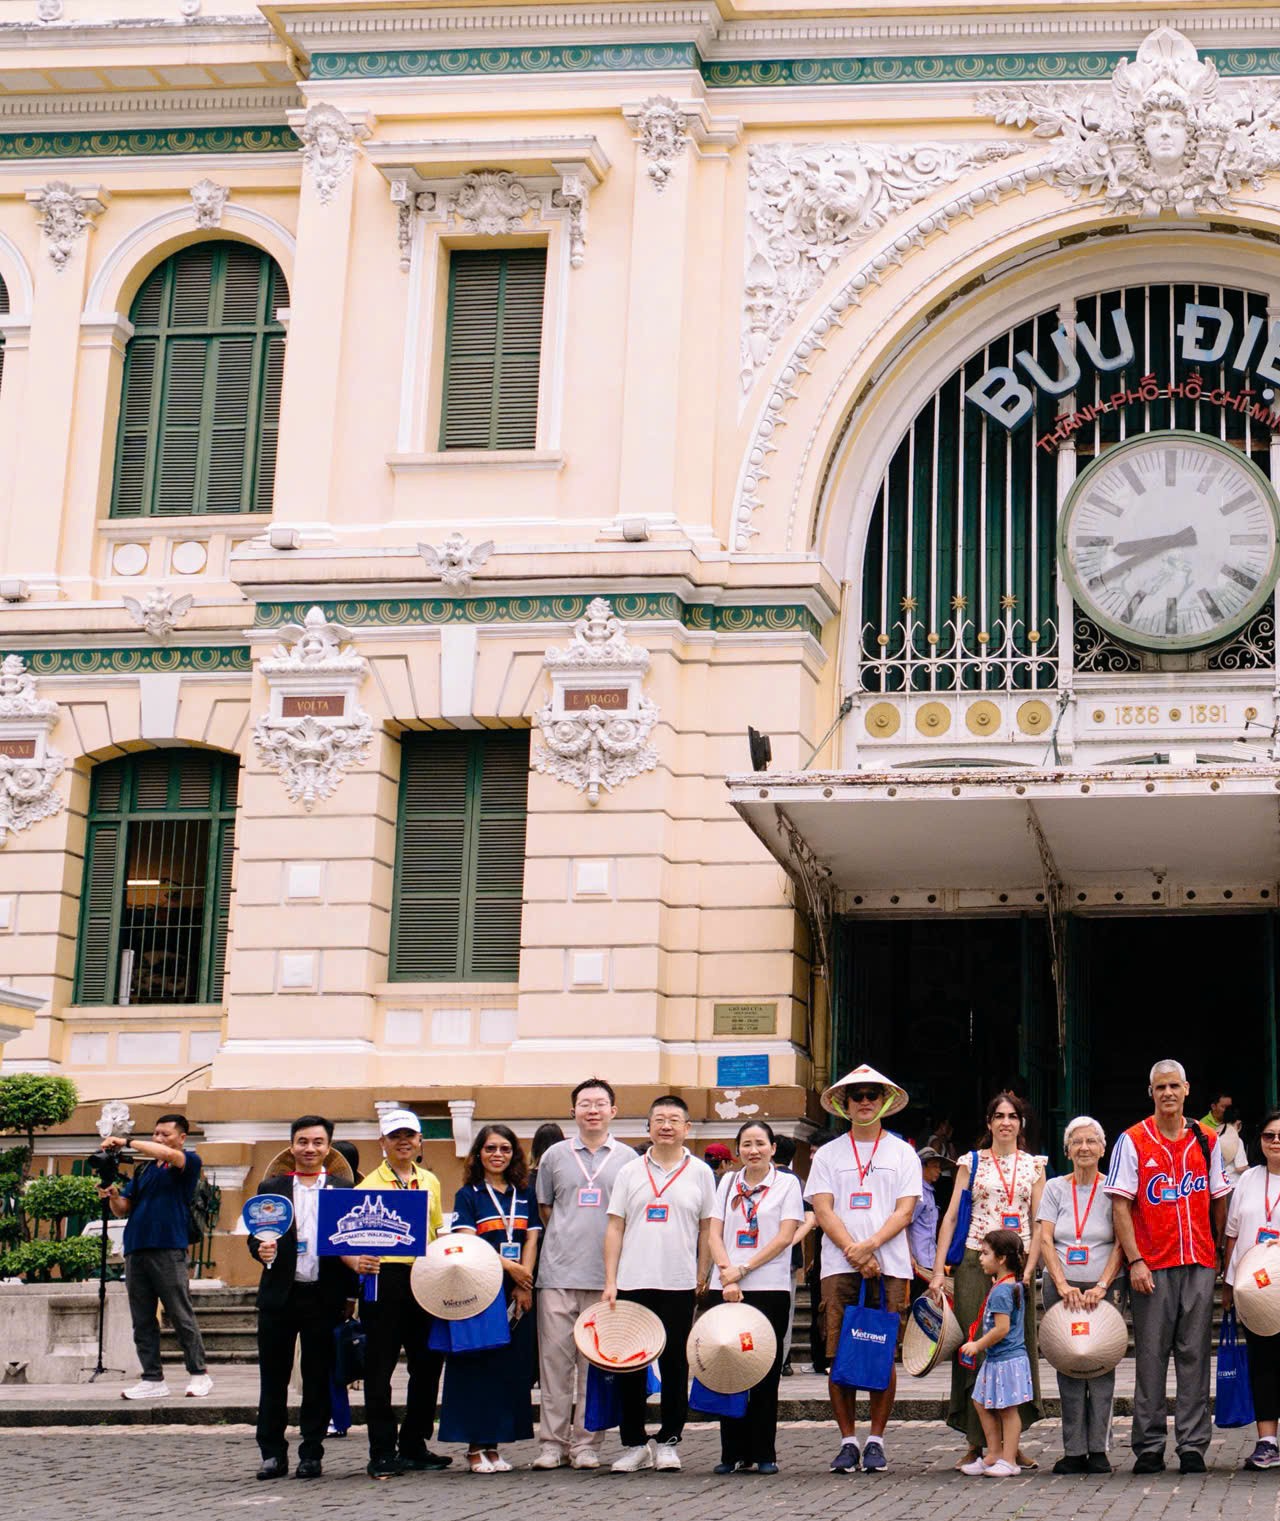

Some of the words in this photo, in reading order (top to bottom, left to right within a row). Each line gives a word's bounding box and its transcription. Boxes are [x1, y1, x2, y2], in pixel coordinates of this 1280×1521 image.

[964, 308, 1136, 431] BƯU
[1035, 403, 1106, 456] THÀNH
[1110, 372, 1159, 411] PHỐ
[1167, 372, 1204, 399] HỒ
[1209, 388, 1257, 414] CHÍ
[584, 693, 620, 705] ARAGO
[297, 700, 329, 712] VOLTA
[1114, 705, 1160, 725] 1886
[1189, 703, 1228, 724] 1891
[333, 1232, 366, 1243] DIPLOMATIC
[367, 1231, 393, 1239] WALKING
[442, 1294, 478, 1307] Vietravel
[851, 1328, 887, 1342] Vietravel
